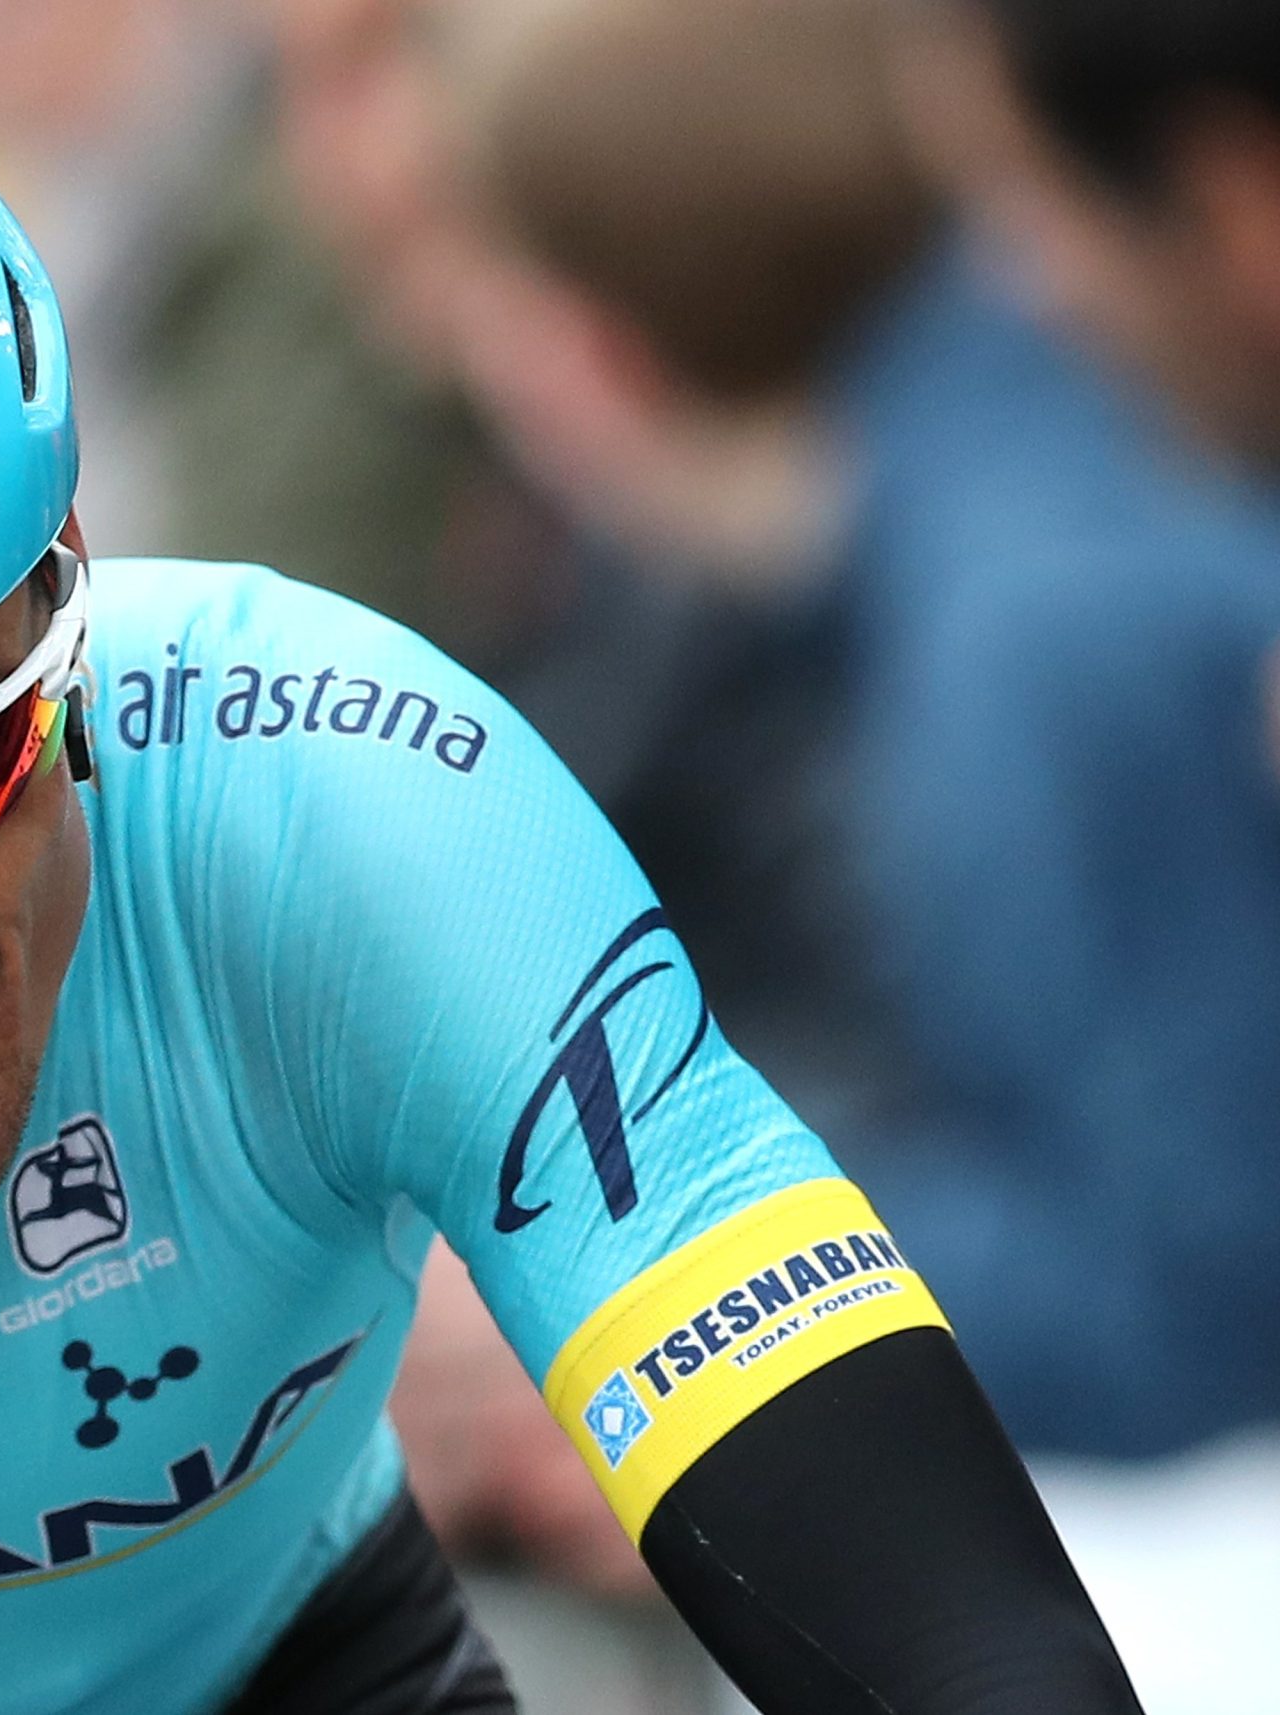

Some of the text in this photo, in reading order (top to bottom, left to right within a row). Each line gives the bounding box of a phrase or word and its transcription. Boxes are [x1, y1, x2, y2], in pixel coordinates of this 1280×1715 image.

[118, 643, 487, 773] air astana
[633, 1232, 904, 1398] TSESNABAN
[733, 1317, 810, 1368] TODAY.
